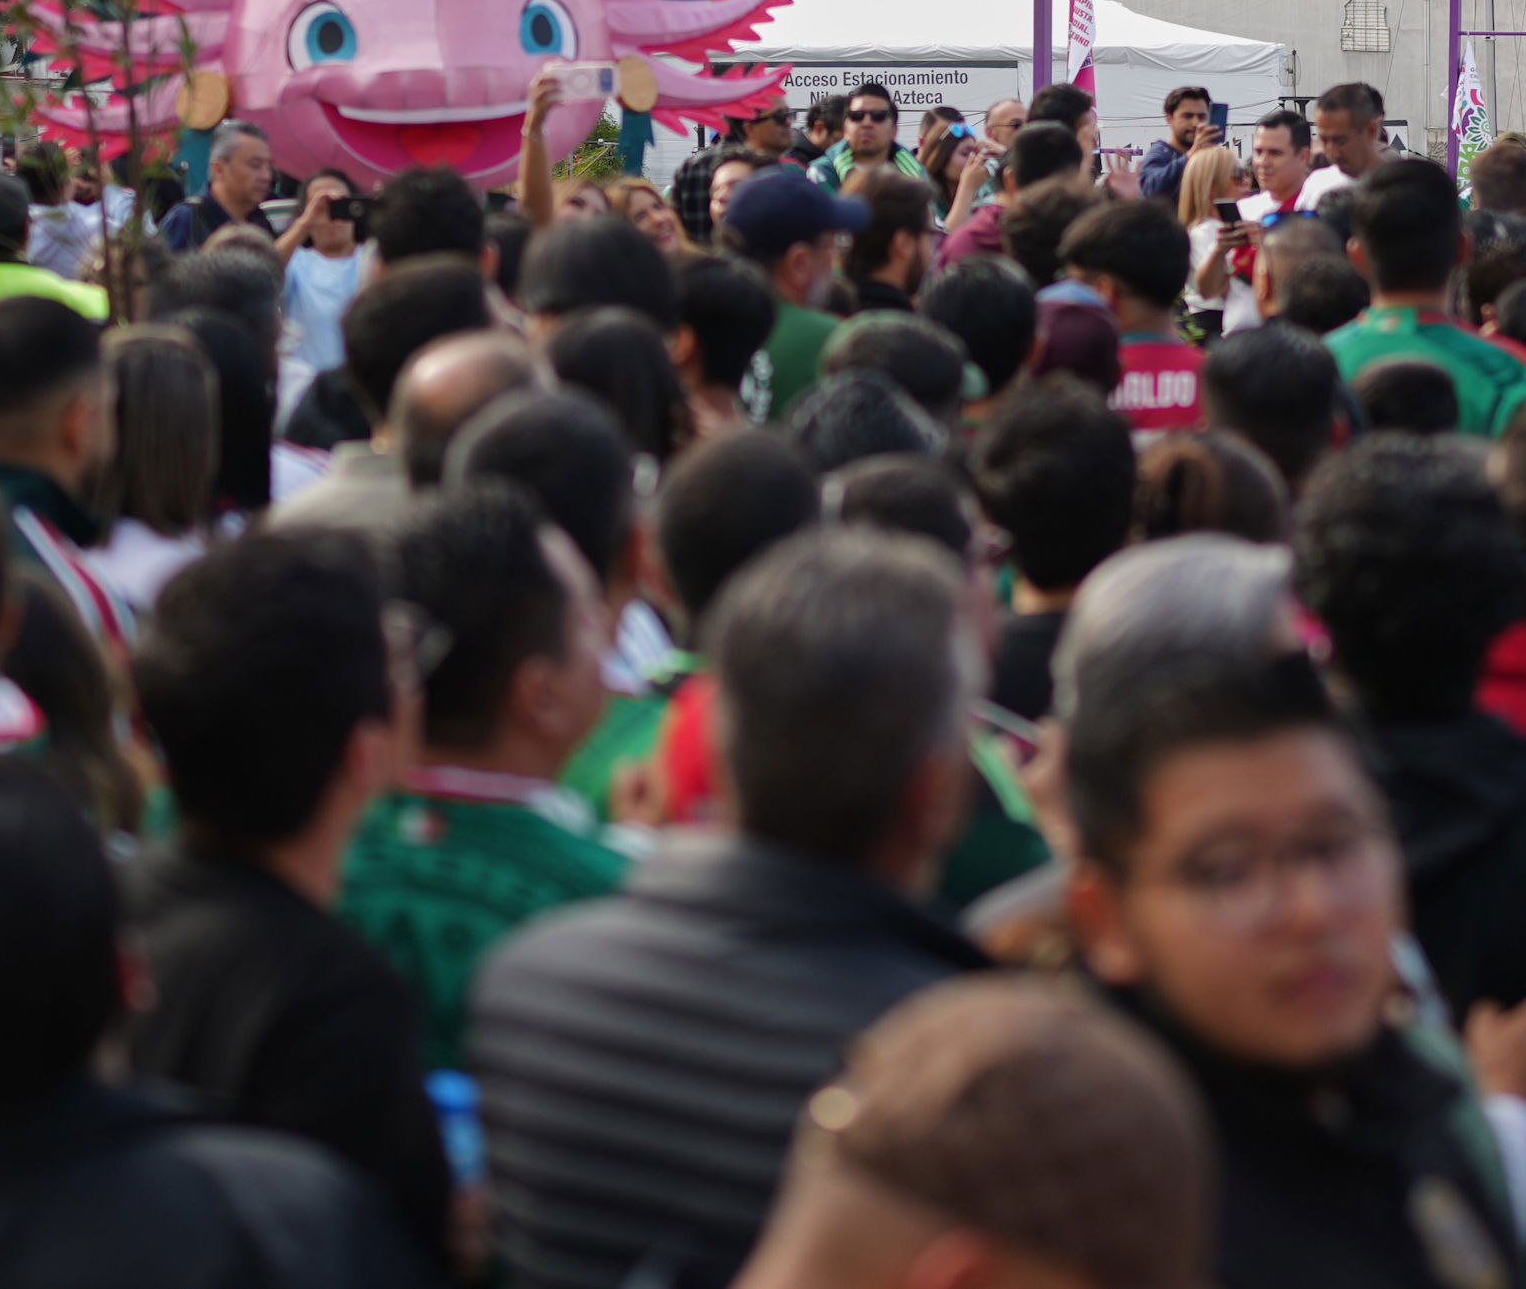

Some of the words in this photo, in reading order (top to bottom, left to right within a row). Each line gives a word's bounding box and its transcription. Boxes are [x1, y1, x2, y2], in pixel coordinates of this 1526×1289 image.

[784, 72, 838, 87] Acceso
[843, 70, 969, 87] Estacionamiento
[894, 90, 943, 105] Azteca
